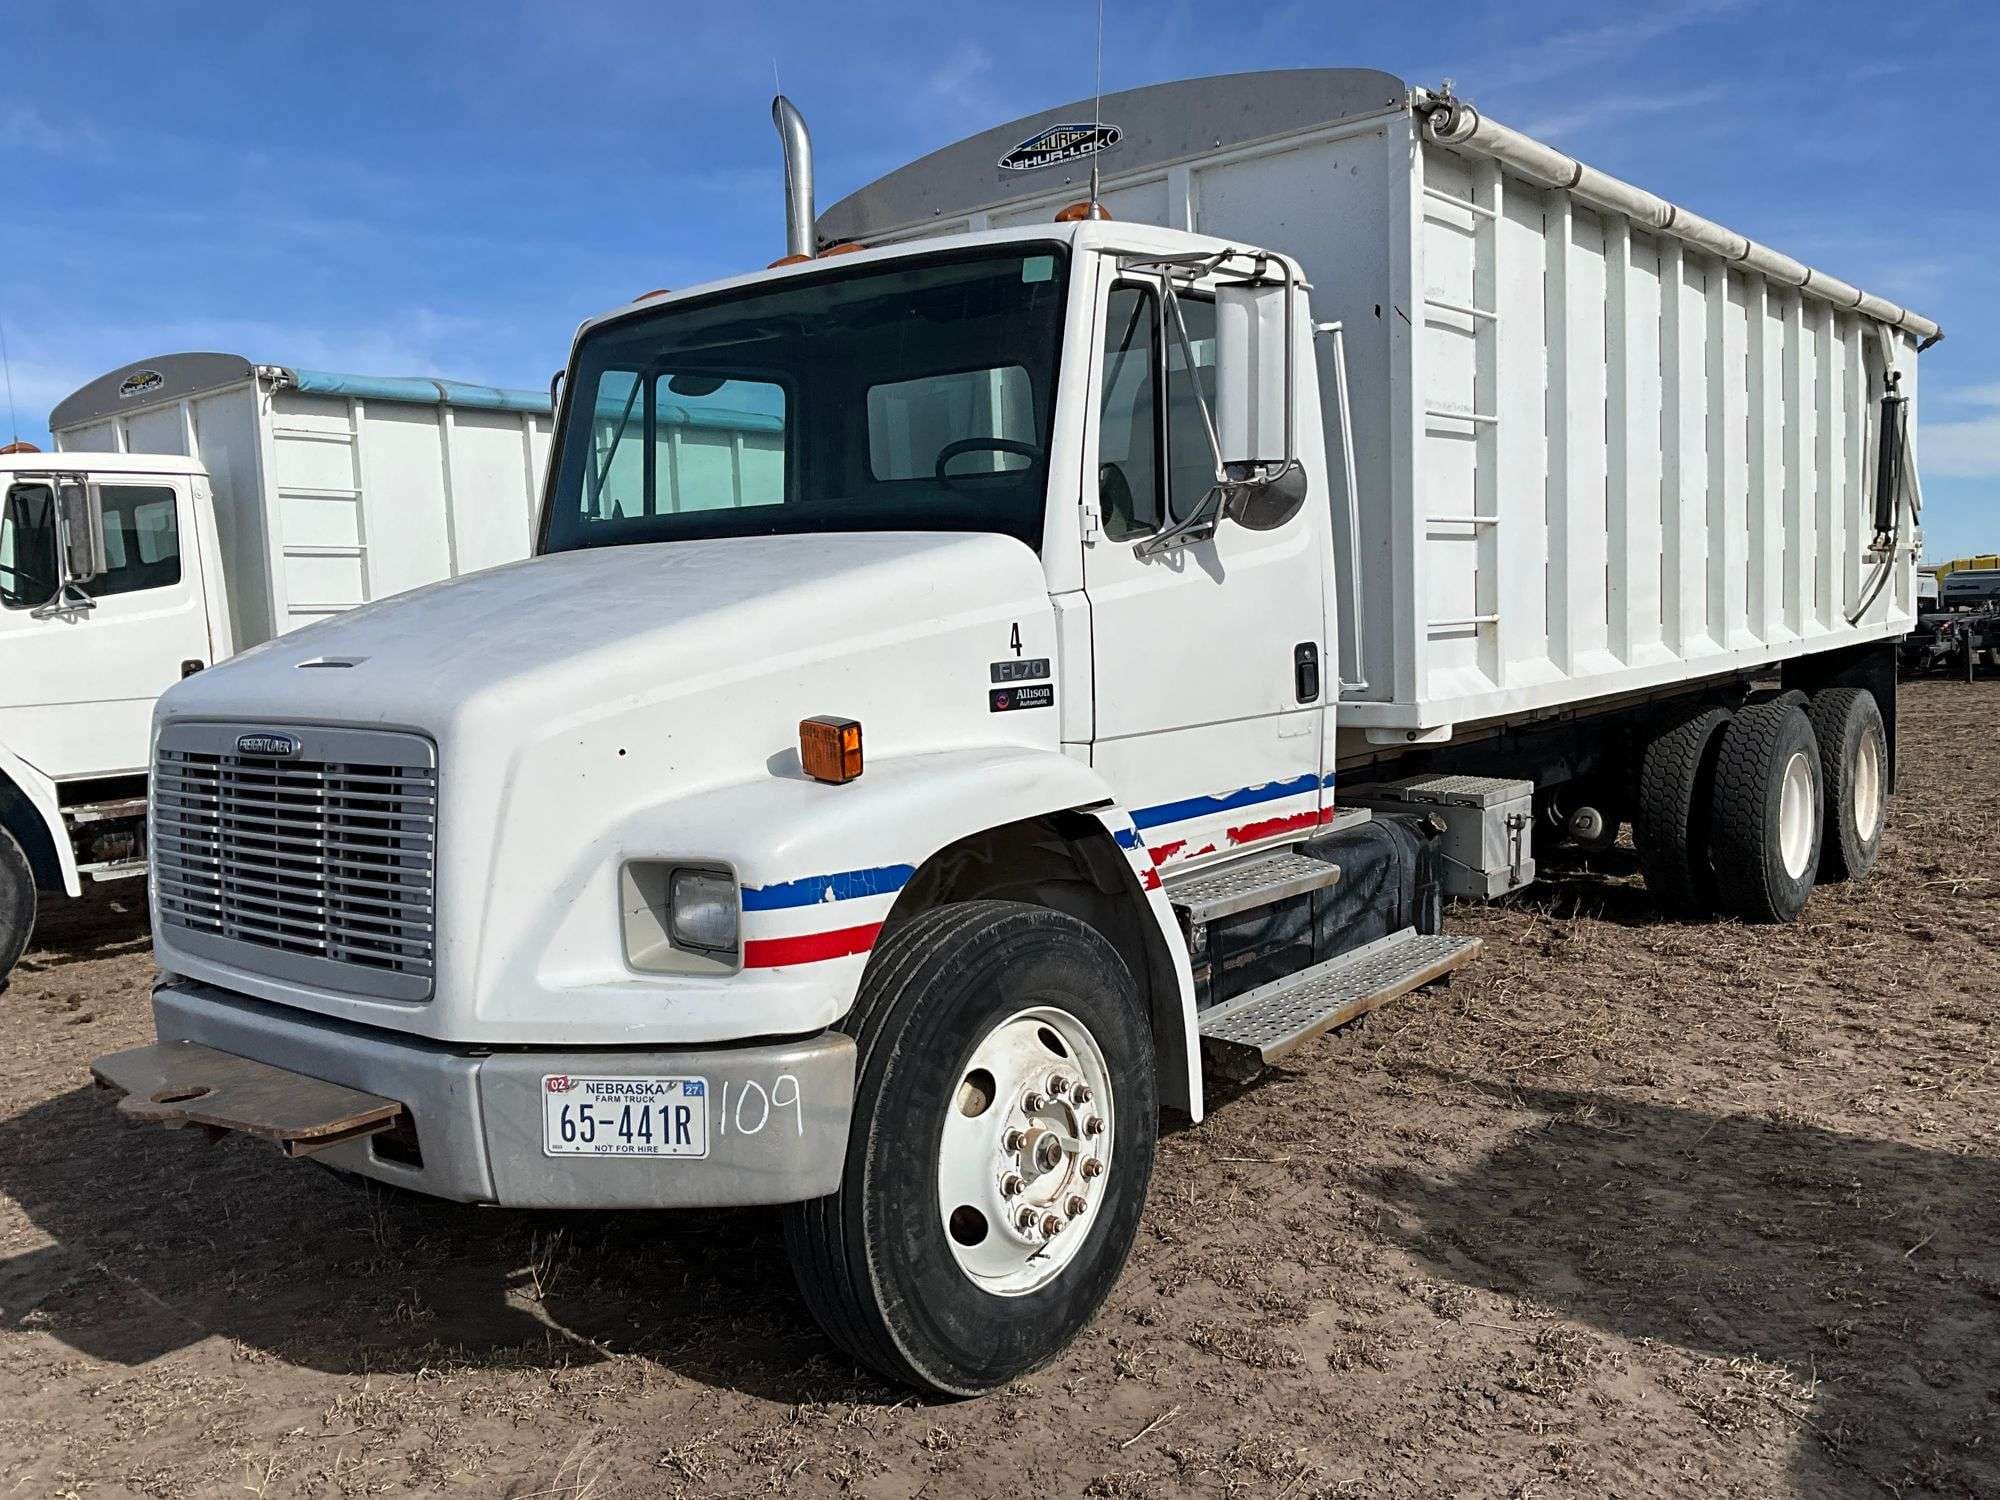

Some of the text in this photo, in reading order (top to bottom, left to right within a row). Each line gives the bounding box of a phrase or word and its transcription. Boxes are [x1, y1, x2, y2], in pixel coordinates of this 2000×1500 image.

[1010, 623, 1023, 657] 4
[998, 660, 1044, 681] FL70
[1016, 688, 1050, 700] Allison
[1019, 699, 1048, 707] Automatic
[550, 1079, 566, 1091] 02
[585, 1082, 665, 1095] NEBRASKA
[685, 1085, 699, 1096] 27
[594, 1095, 656, 1103] FARM TRUCK
[720, 1074, 804, 1137] 109
[560, 1103, 692, 1145] 65-441R
[594, 1144, 659, 1153] NOT FOR HIRE
